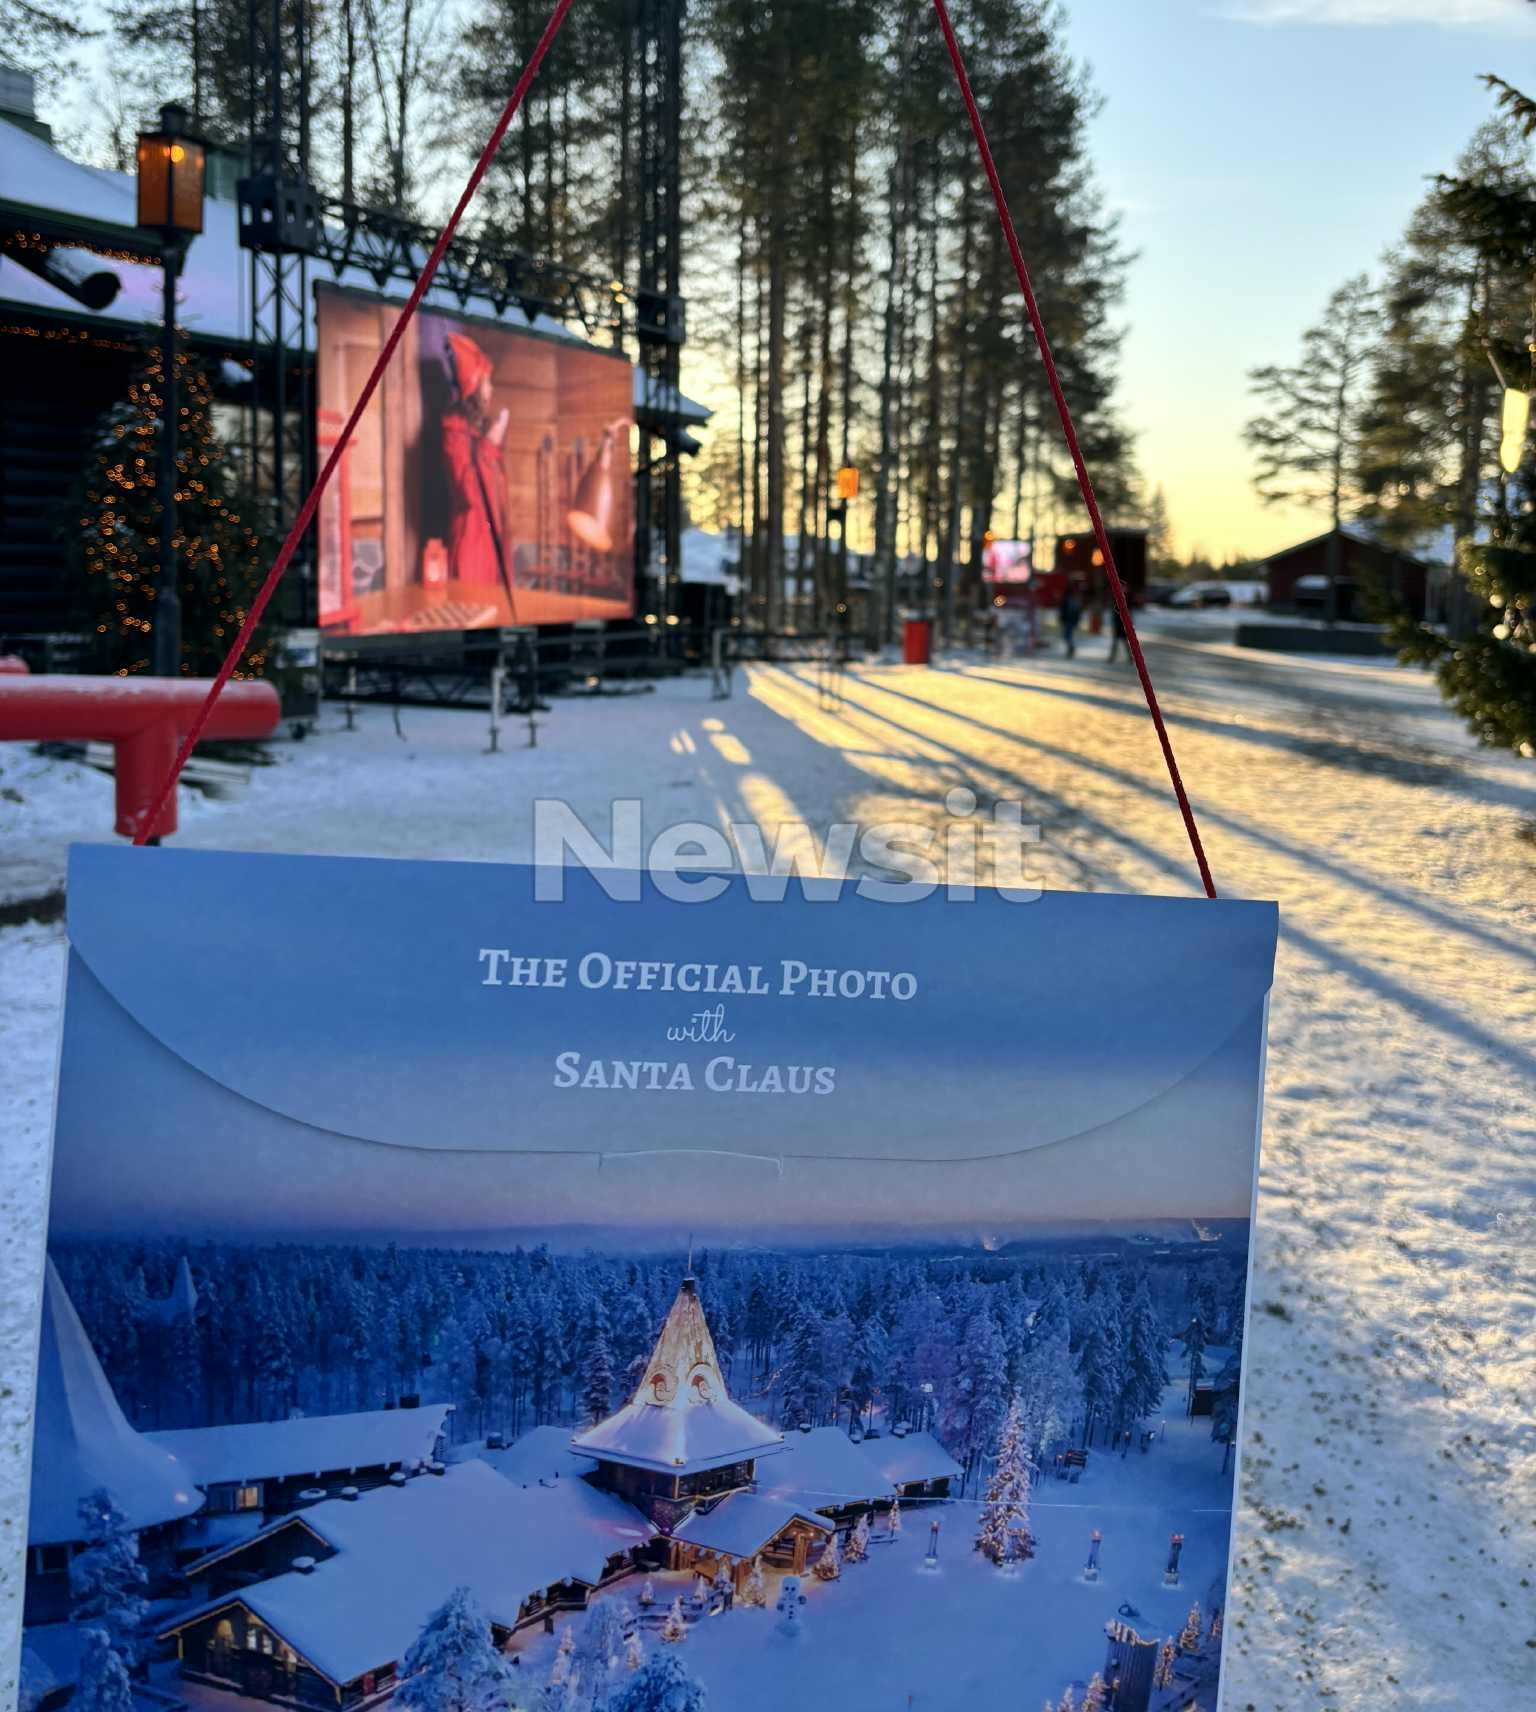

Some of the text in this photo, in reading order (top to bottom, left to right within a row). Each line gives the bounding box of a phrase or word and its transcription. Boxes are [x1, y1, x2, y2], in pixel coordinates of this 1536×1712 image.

[479, 948, 918, 1000] THE OFFICIAL PHOTO
[667, 1003, 736, 1044] with
[553, 1051, 836, 1095] SANTA CLAUS
